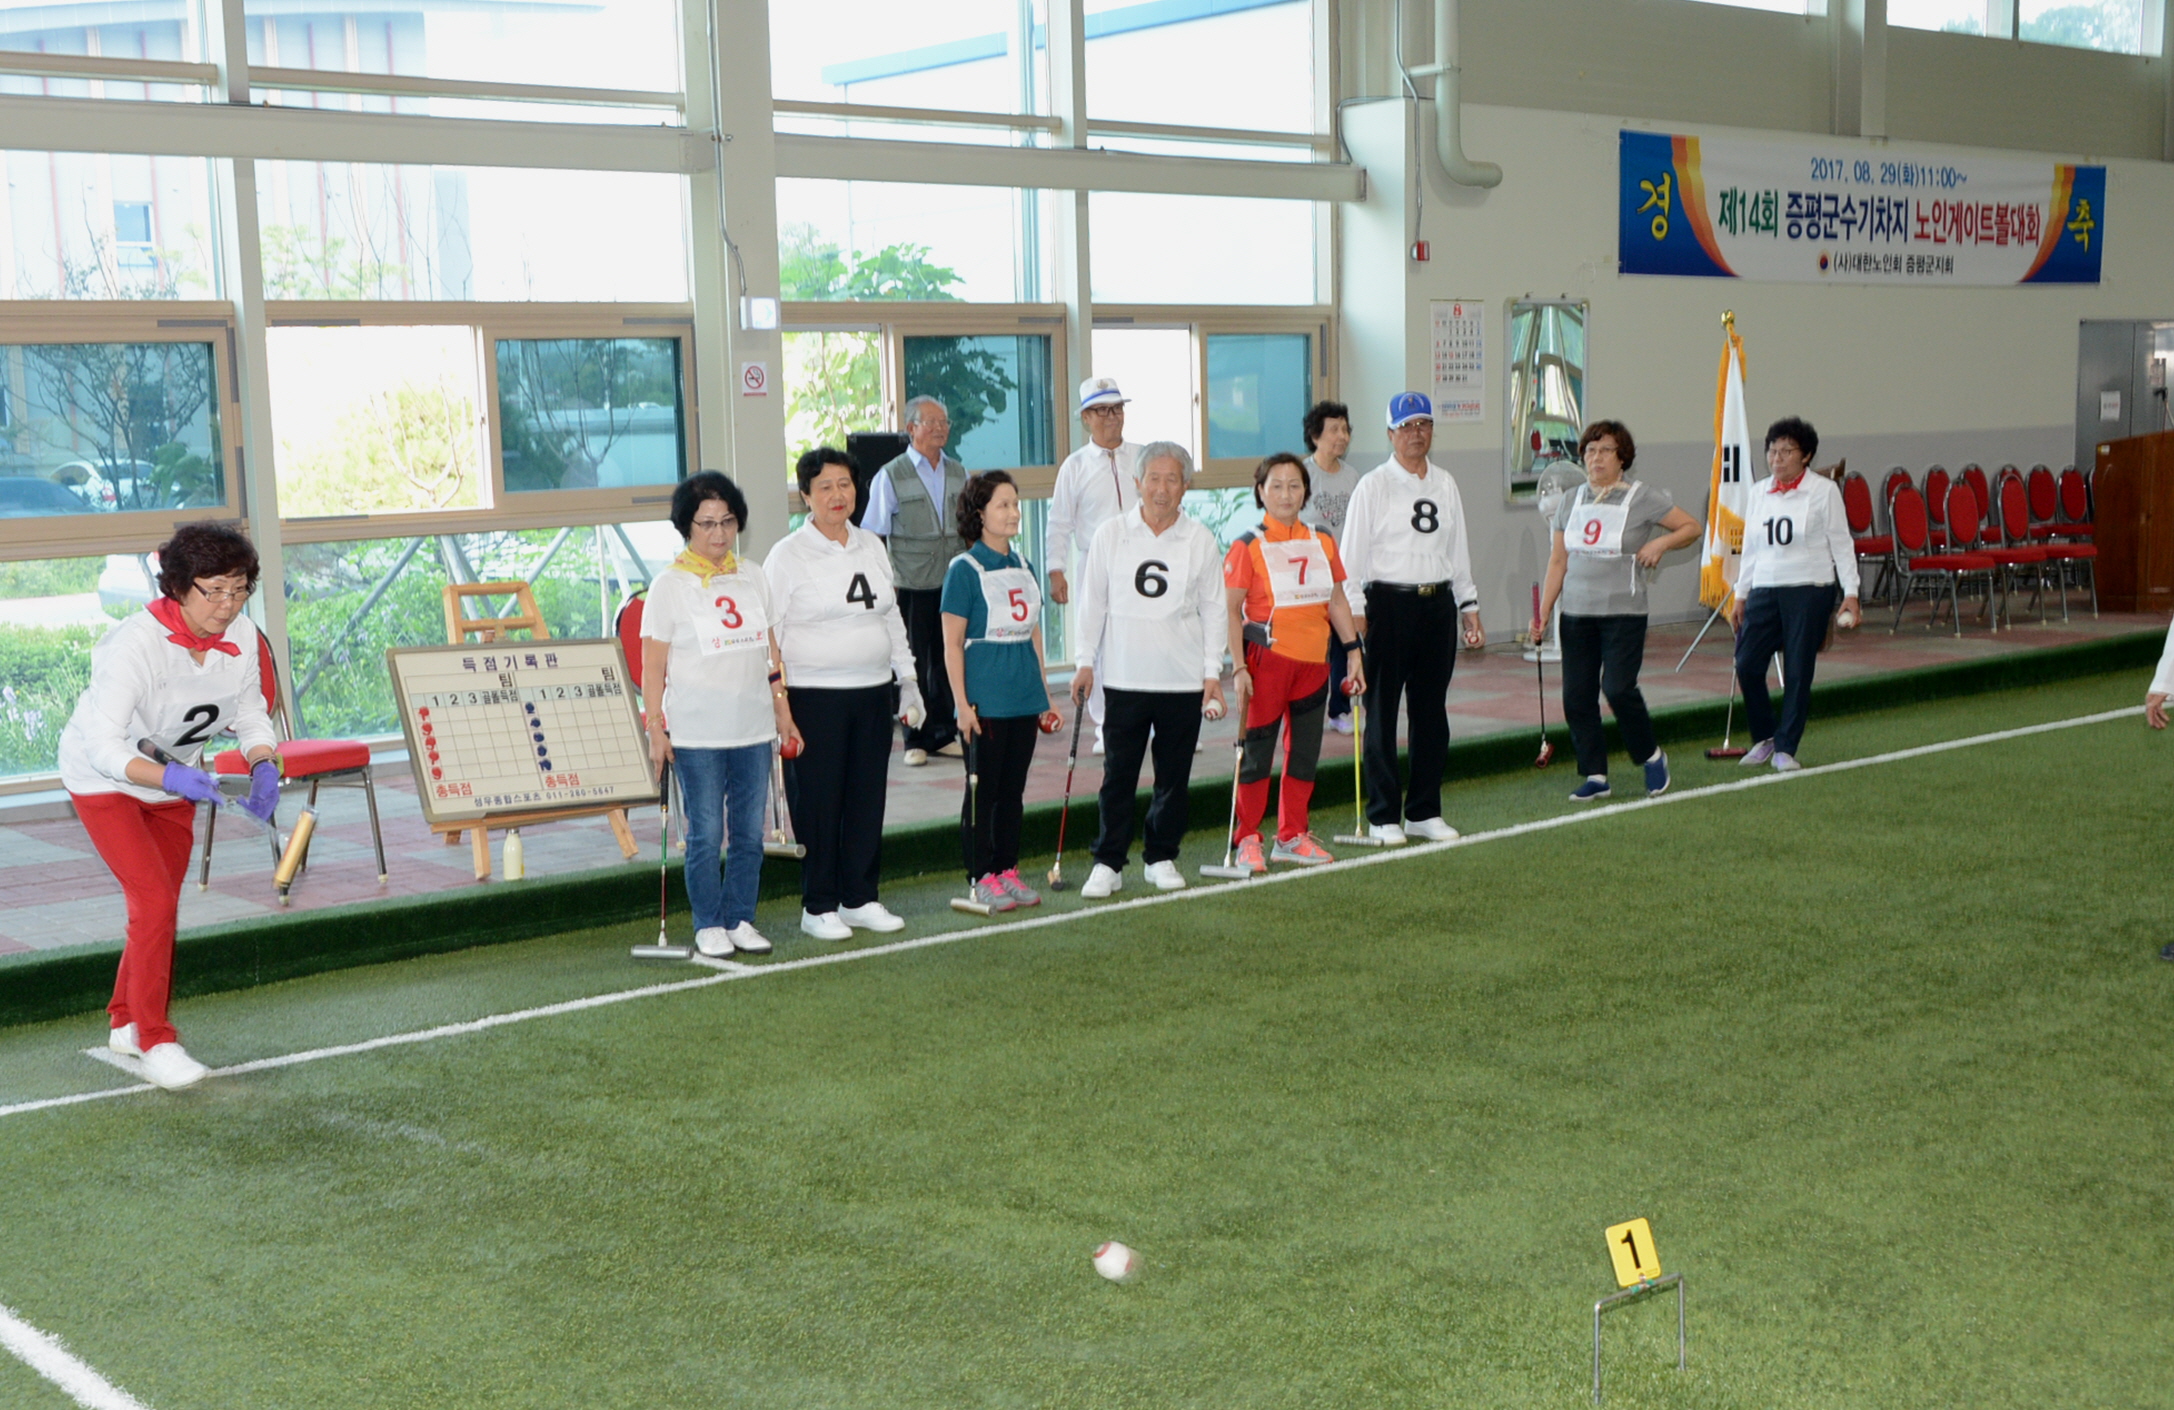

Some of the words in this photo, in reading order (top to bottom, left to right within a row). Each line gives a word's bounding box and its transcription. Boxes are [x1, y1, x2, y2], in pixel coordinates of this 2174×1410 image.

[1811, 157, 1848, 183] 2017.
[1854, 160, 1874, 185] 08.
[1636, 171, 1671, 241] 경
[1718, 186, 1779, 238] 제14회
[1785, 191, 1909, 243] 증평군수기차지
[1913, 199, 2041, 247] 노인게이트볼대회
[2066, 198, 2095, 254] 축
[1833, 250, 1903, 274] (사)대한노인회
[1906, 254, 1954, 276] 증평군지회
[1410, 498, 1439, 534] 8
[1763, 515, 1793, 546] 10
[1583, 518, 1602, 546] 9
[1134, 559, 1170, 598] 6
[1287, 556, 1309, 586] 7
[846, 571, 878, 610] 4
[1008, 588, 1029, 622] 5
[715, 595, 743, 629] 3
[462, 652, 559, 673] 득점기록판
[601, 666, 616, 682] 팀
[499, 671, 513, 688] 팀
[540, 689, 547, 700] 1
[556, 687, 566, 699] 2
[574, 685, 583, 697] 3
[604, 682, 622, 696] 득점
[432, 695, 439, 707] 1
[449, 693, 459, 706] 2
[468, 692, 478, 705] 3
[500, 689, 519, 703] 득점
[172, 703, 220, 748] 2
[436, 781, 473, 798] 총득점
[545, 772, 581, 788] 총득점
[1620, 1228, 1641, 1270] 1
